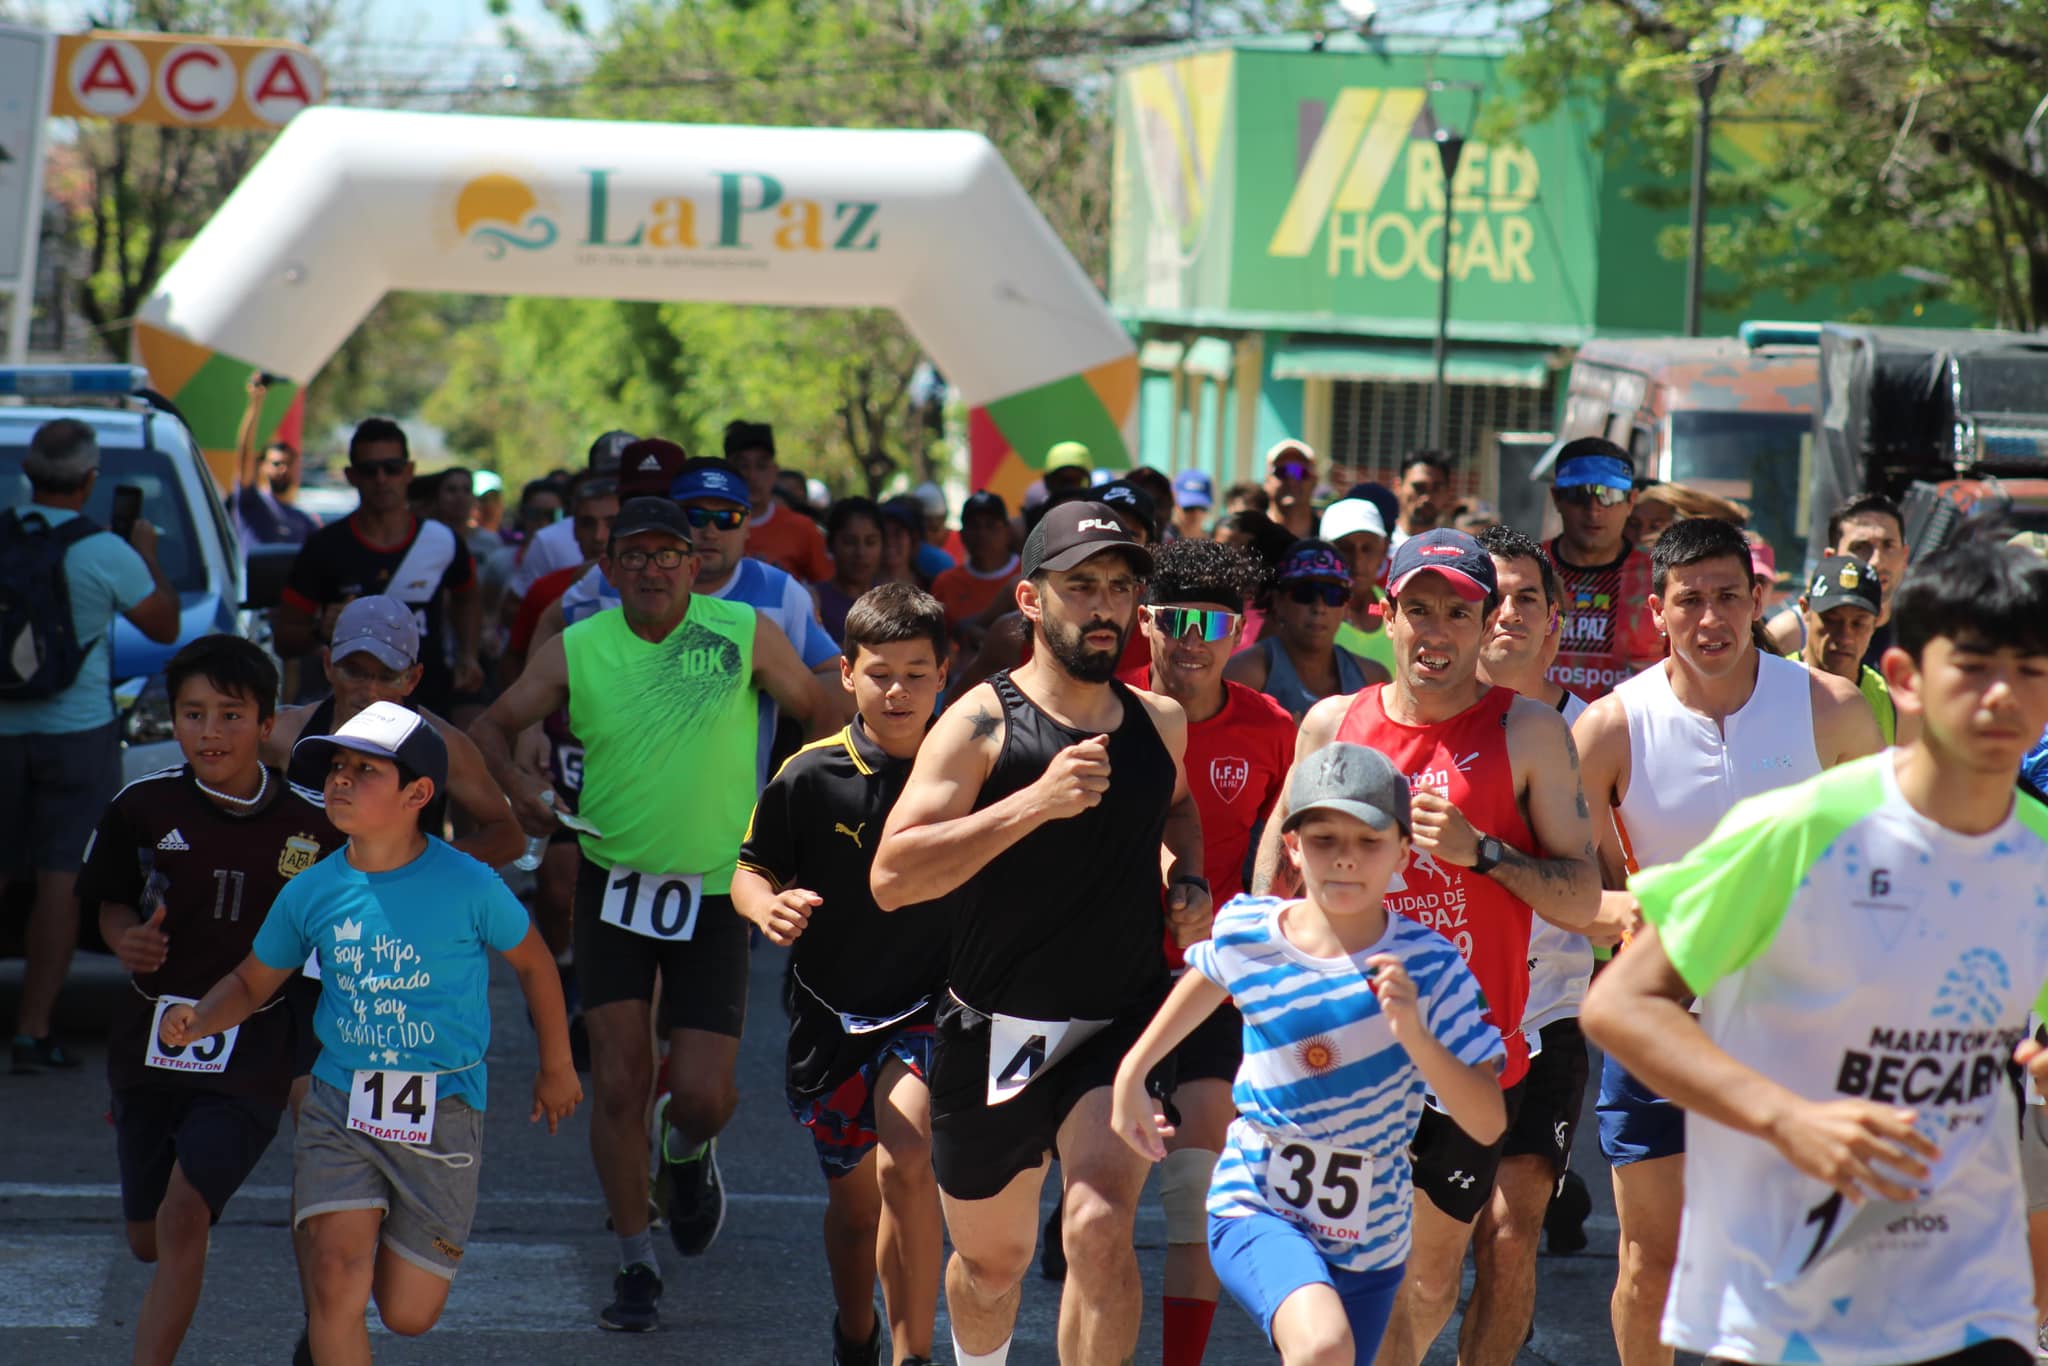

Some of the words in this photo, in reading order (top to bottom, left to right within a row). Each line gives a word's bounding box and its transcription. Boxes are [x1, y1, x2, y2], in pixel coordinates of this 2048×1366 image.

[80, 45, 311, 112] ACA
[1406, 140, 1540, 211] RED
[1327, 212, 1535, 282] HOGAR
[1576, 617, 1608, 640] PAZ
[679, 645, 725, 677] 10K
[612, 871, 692, 937] 10
[1443, 888, 1467, 906] DE
[1419, 903, 1468, 931] PAZ
[374, 998, 407, 1024] soy
[152, 1056, 222, 1071] TETRATLON
[363, 1071, 426, 1124] 14
[351, 1118, 427, 1142] TETRATLON
[1274, 1143, 1363, 1220] 35
